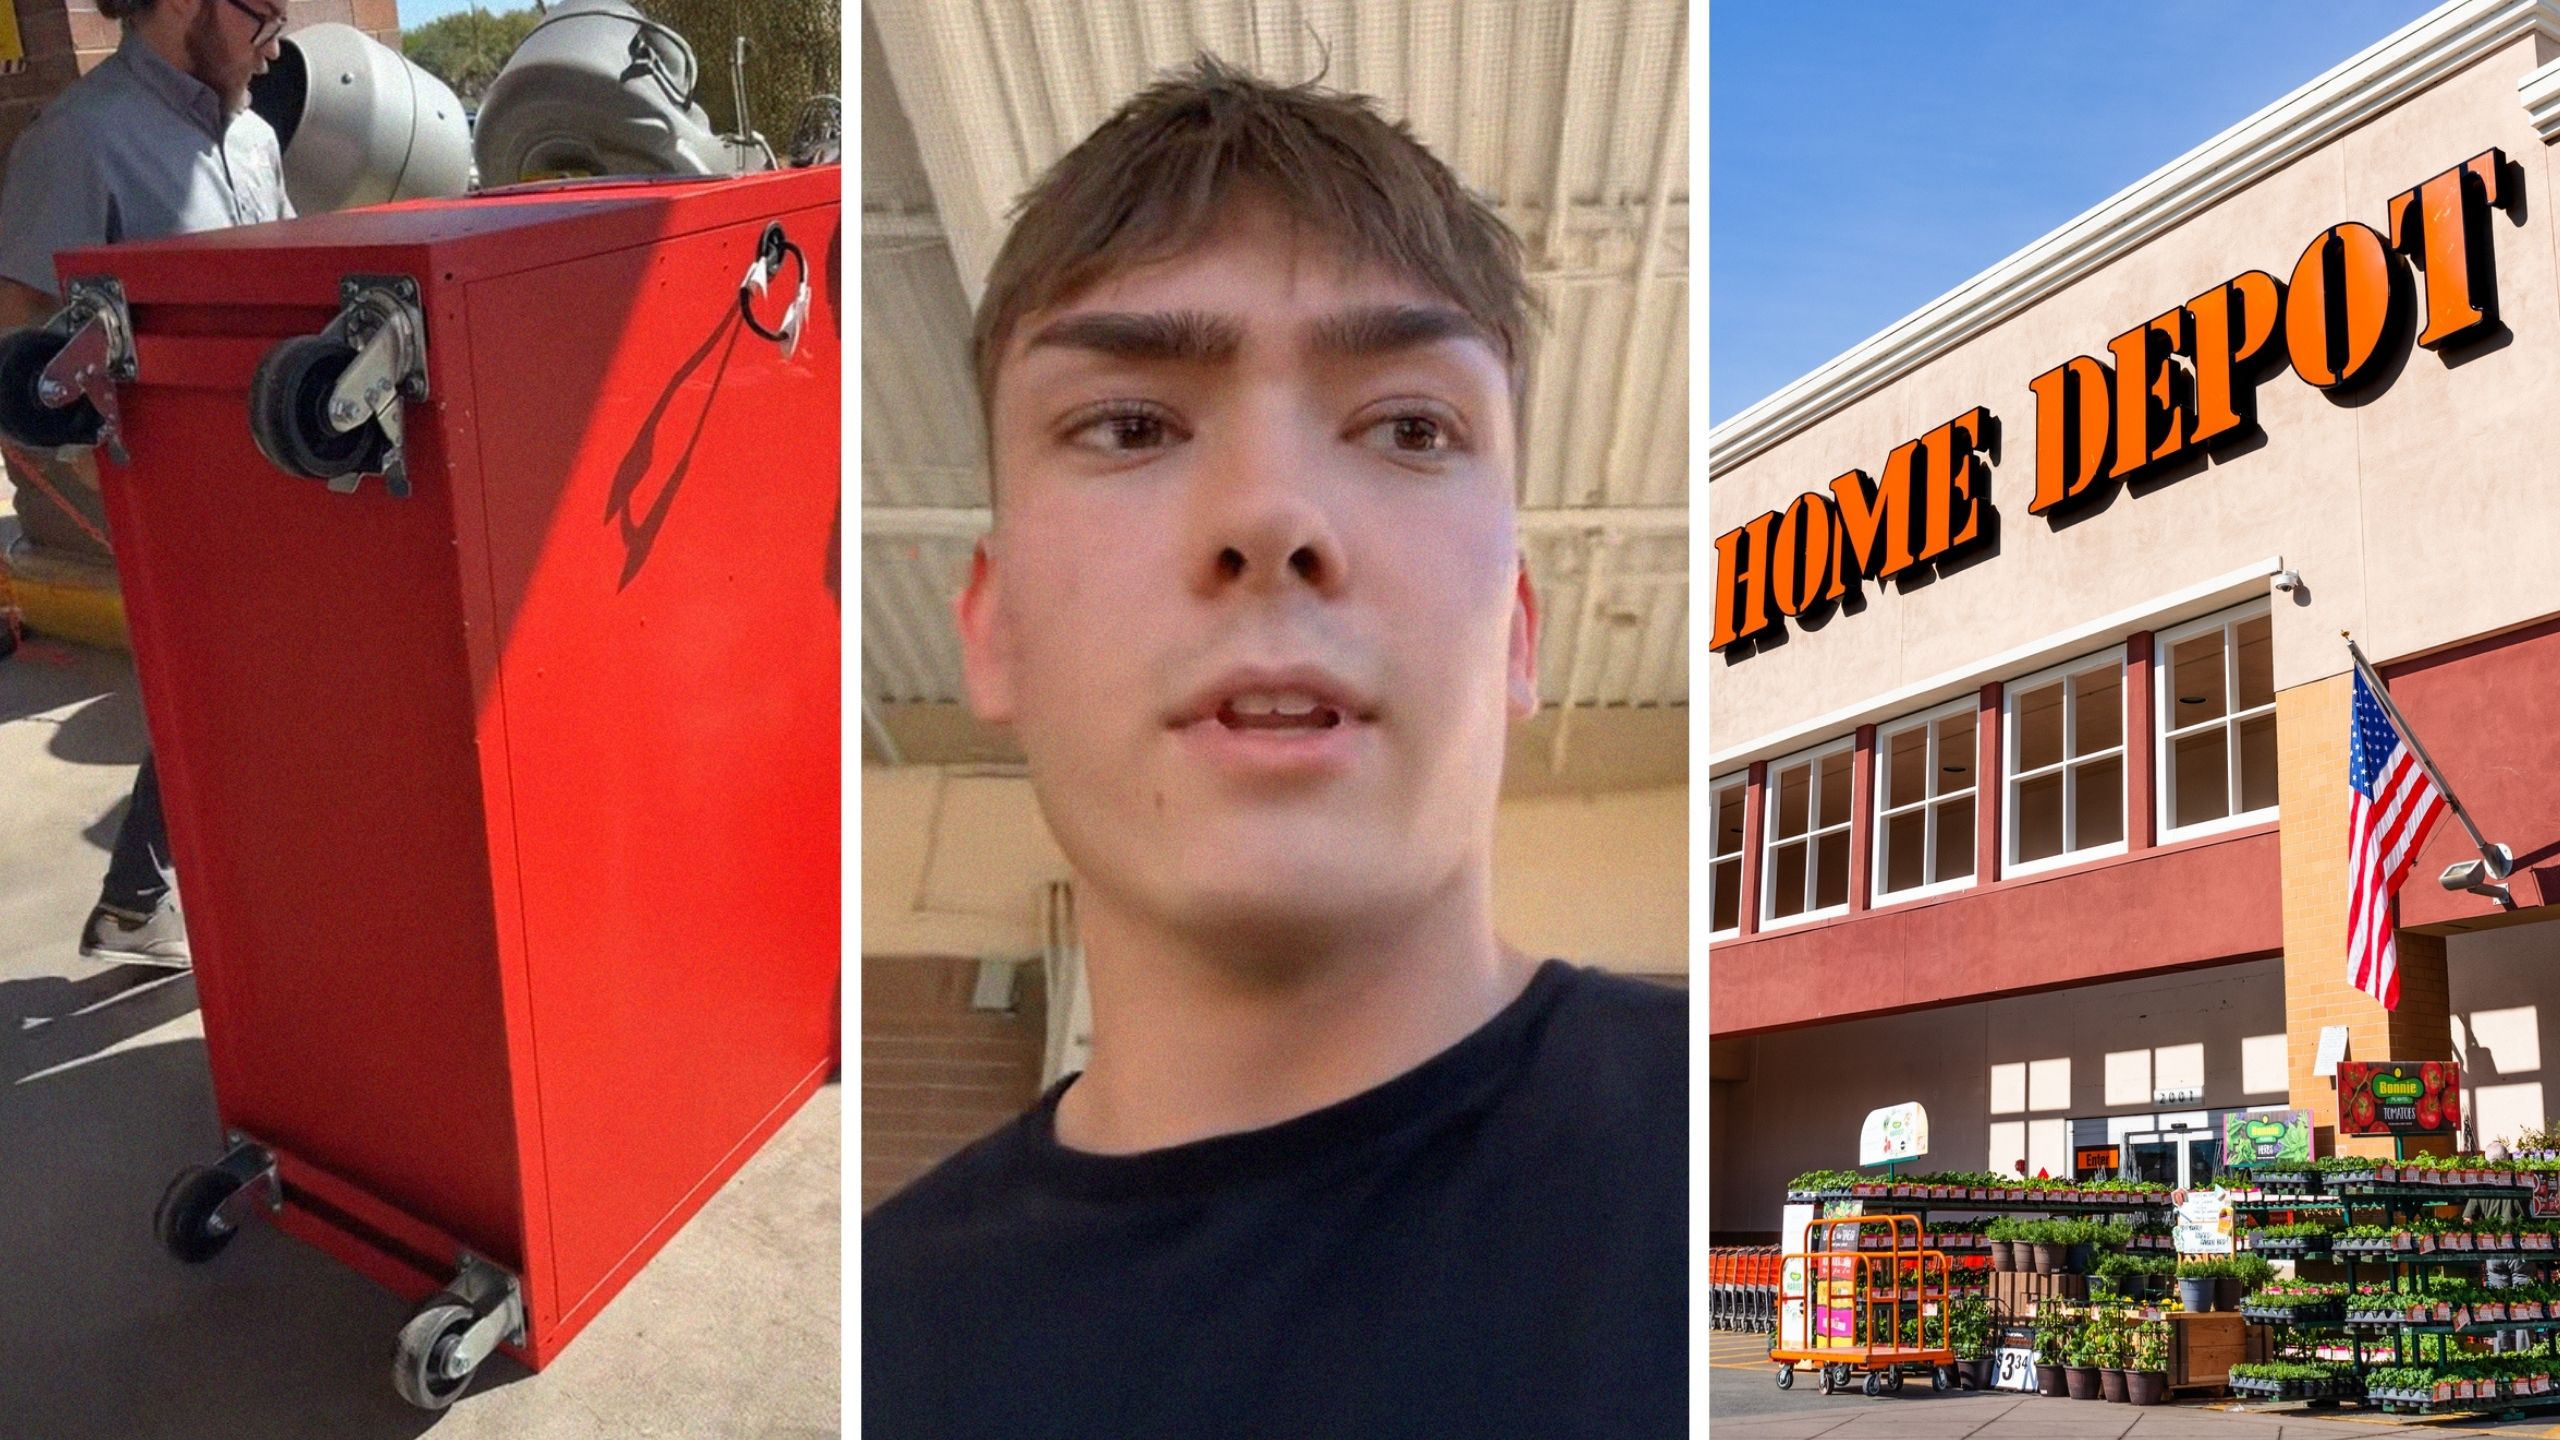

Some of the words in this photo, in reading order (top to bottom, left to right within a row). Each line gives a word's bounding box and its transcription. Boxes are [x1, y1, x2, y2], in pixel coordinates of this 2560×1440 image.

[1710, 406, 1985, 652] HOME
[2028, 147, 2502, 515] DEPOT
[2380, 1081, 2417, 1094] Bonnie
[2159, 1090, 2193, 1104] 2001
[2384, 1107, 2416, 1120] TOMATOES
[2086, 1153, 2110, 1167] Enter
